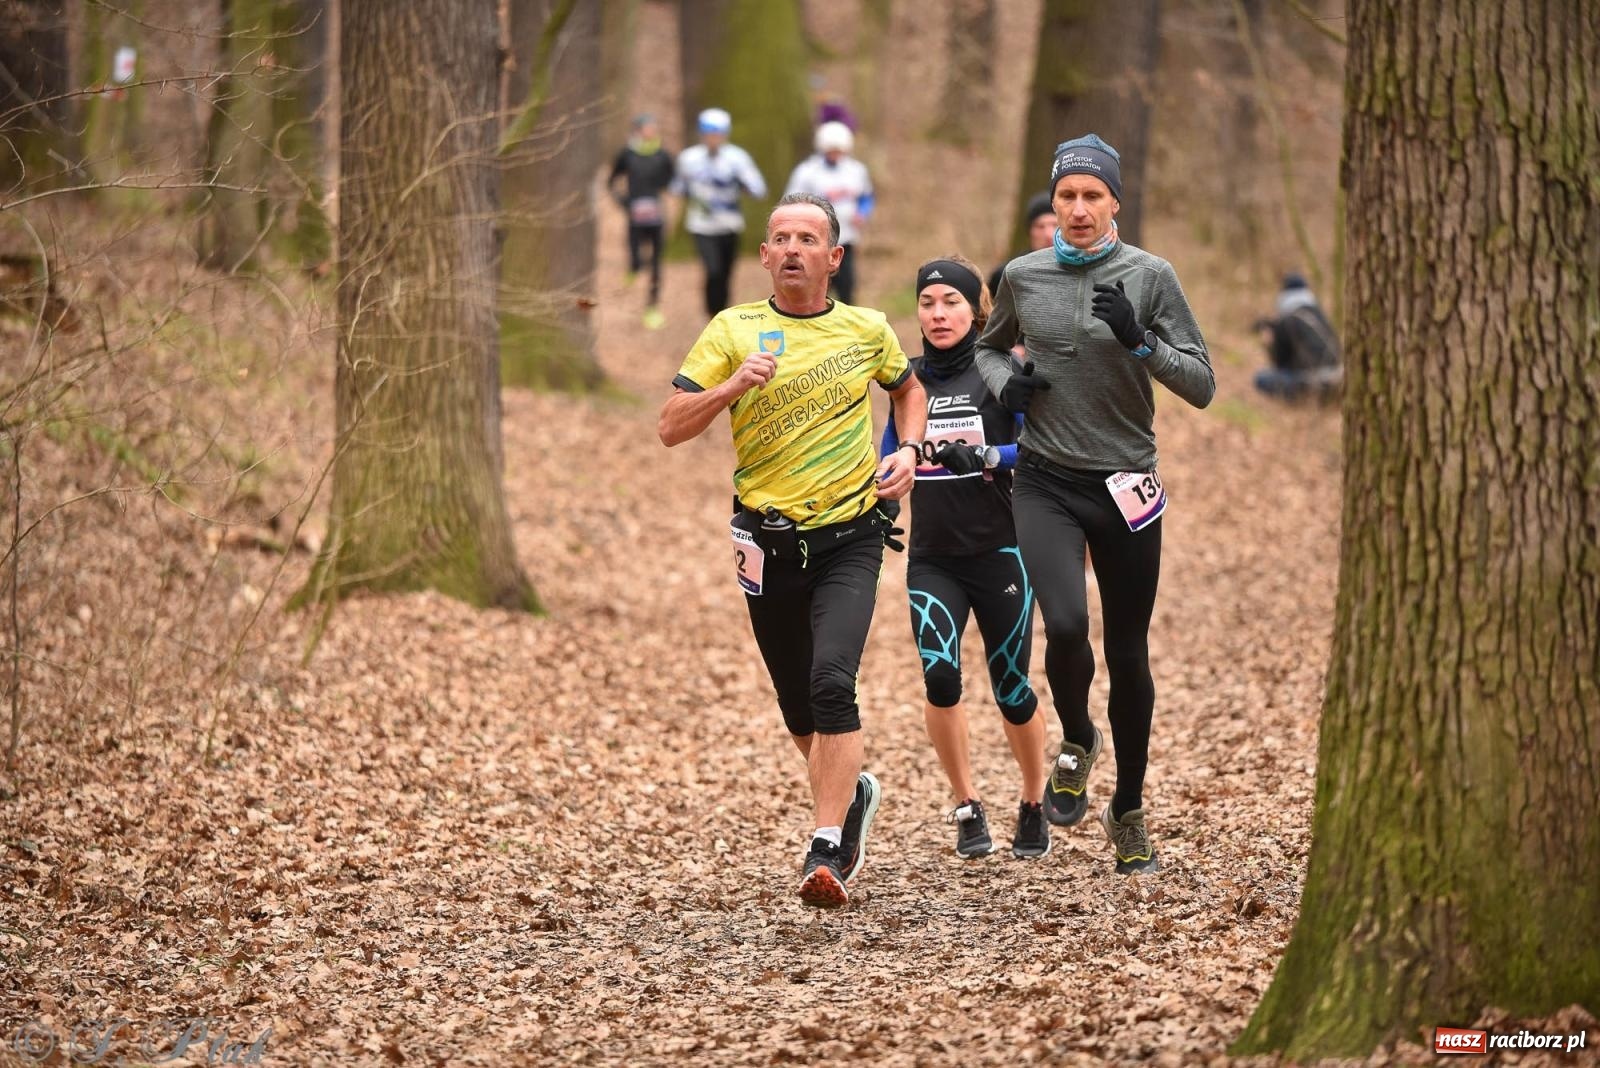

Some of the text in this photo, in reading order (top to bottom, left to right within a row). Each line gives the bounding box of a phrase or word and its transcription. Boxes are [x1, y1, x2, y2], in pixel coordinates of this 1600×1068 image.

[751, 344, 864, 423] JEJKOWICE
[929, 420, 975, 429] Twardziela
[735, 549, 746, 573] 2
